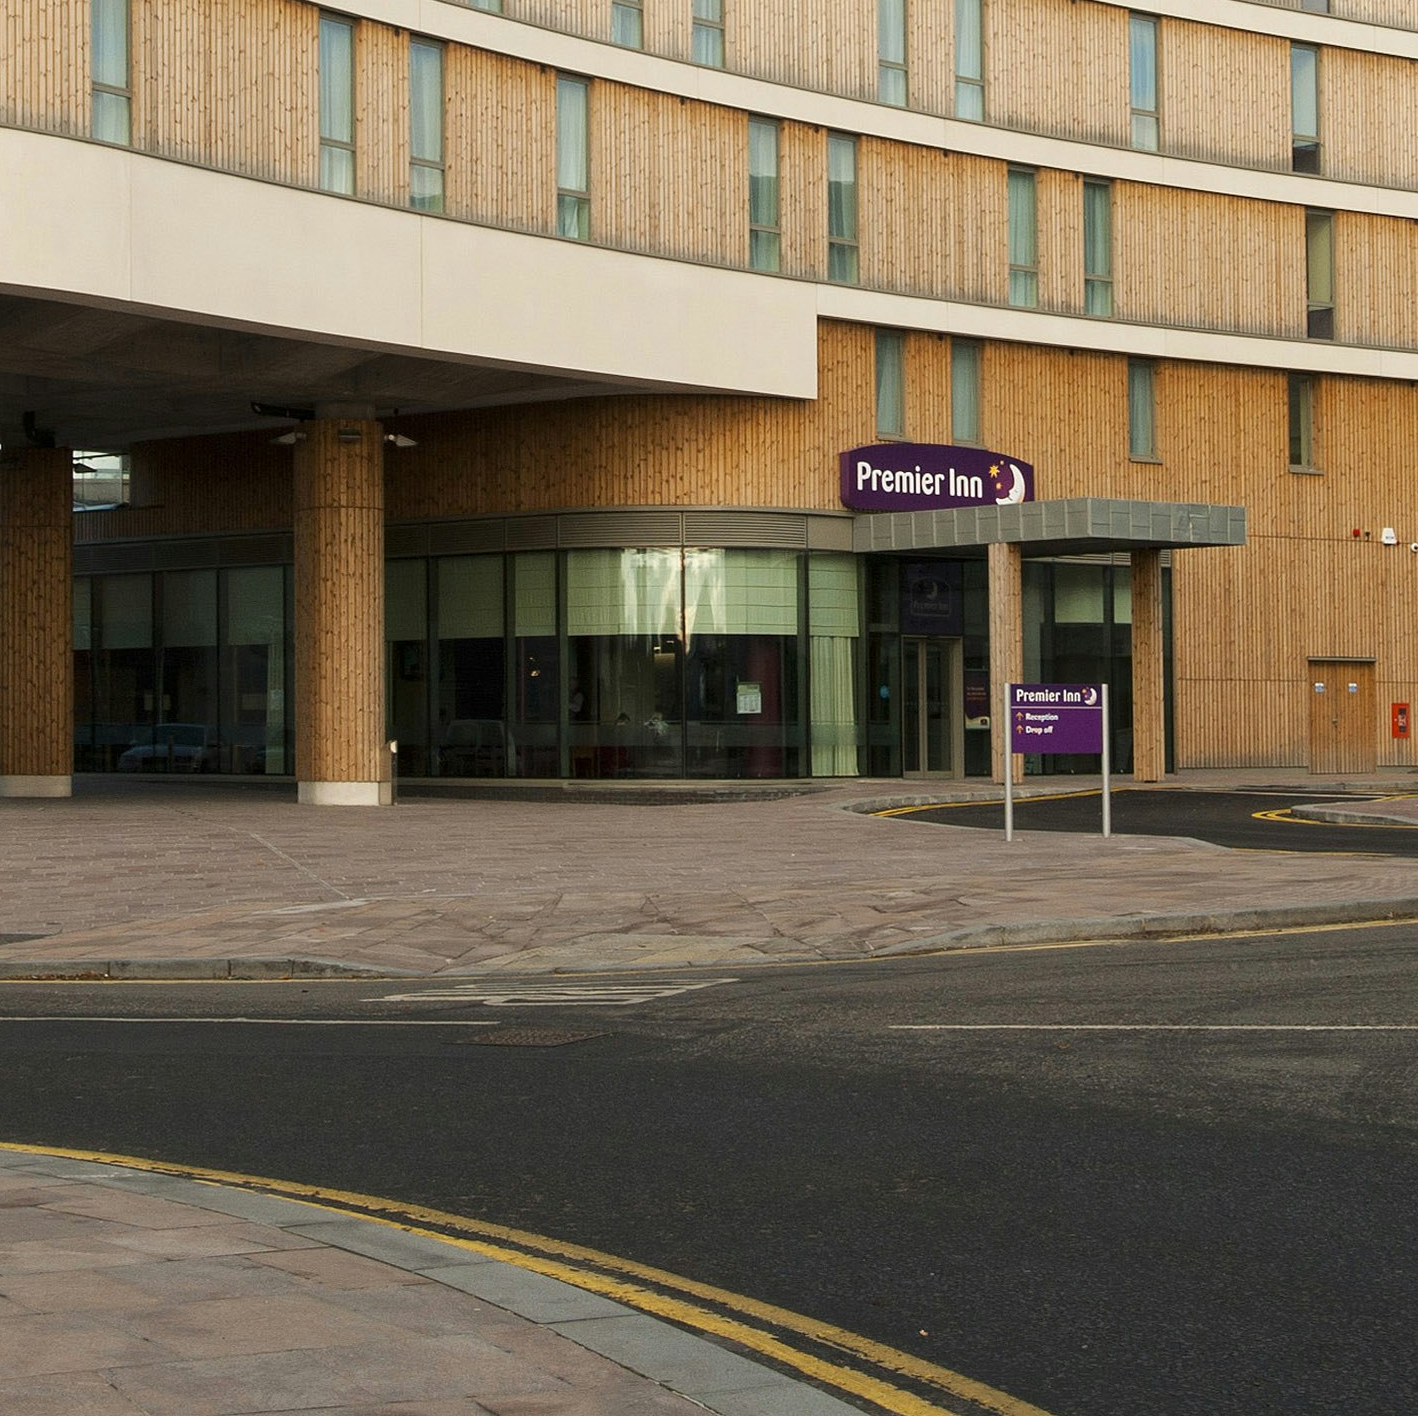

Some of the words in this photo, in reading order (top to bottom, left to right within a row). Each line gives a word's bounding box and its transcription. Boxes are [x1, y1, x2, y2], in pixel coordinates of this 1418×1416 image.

[856, 461, 945, 496] Premier
[949, 468, 983, 498] Inn
[1016, 688, 1061, 702] Premier
[1063, 689, 1081, 702] Inn
[1025, 712, 1059, 722] Reception
[1025, 725, 1043, 735] Drop
[1043, 725, 1053, 734] off
